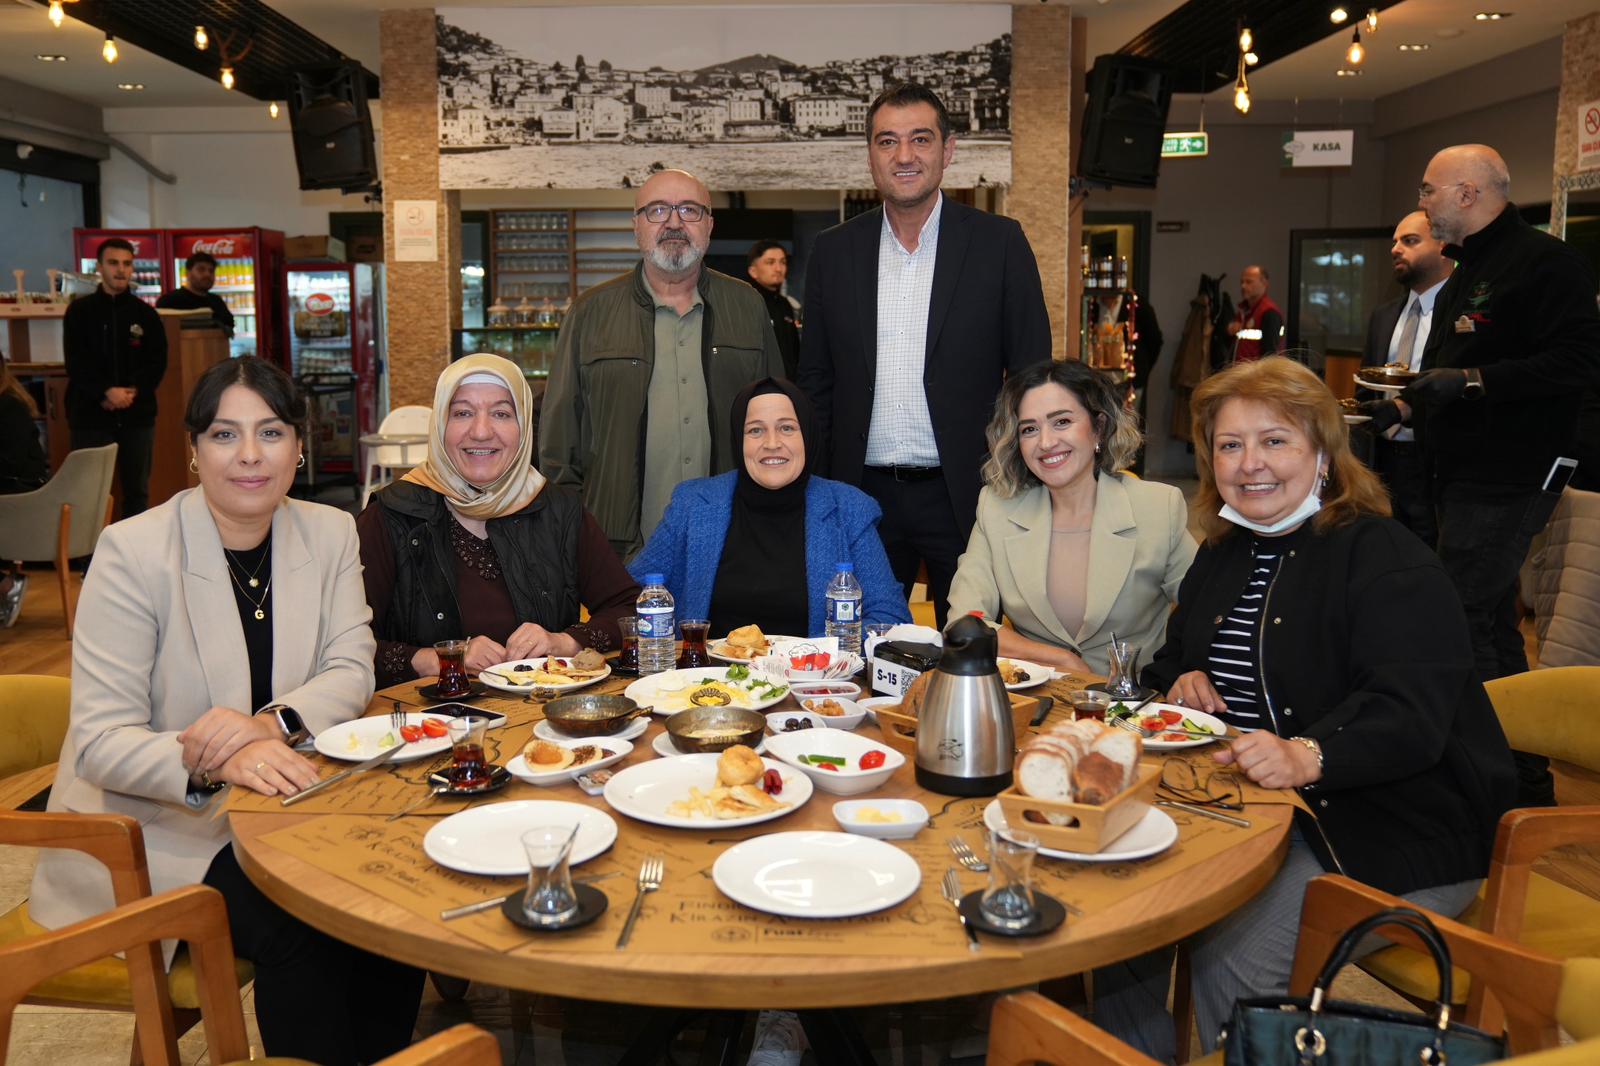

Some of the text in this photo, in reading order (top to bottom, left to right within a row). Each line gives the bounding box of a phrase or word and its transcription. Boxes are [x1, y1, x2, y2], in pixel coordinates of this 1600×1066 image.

[1312, 142, 1341, 152] KASA
[254, 609, 265, 620] G
[877, 668, 897, 686] S-15
